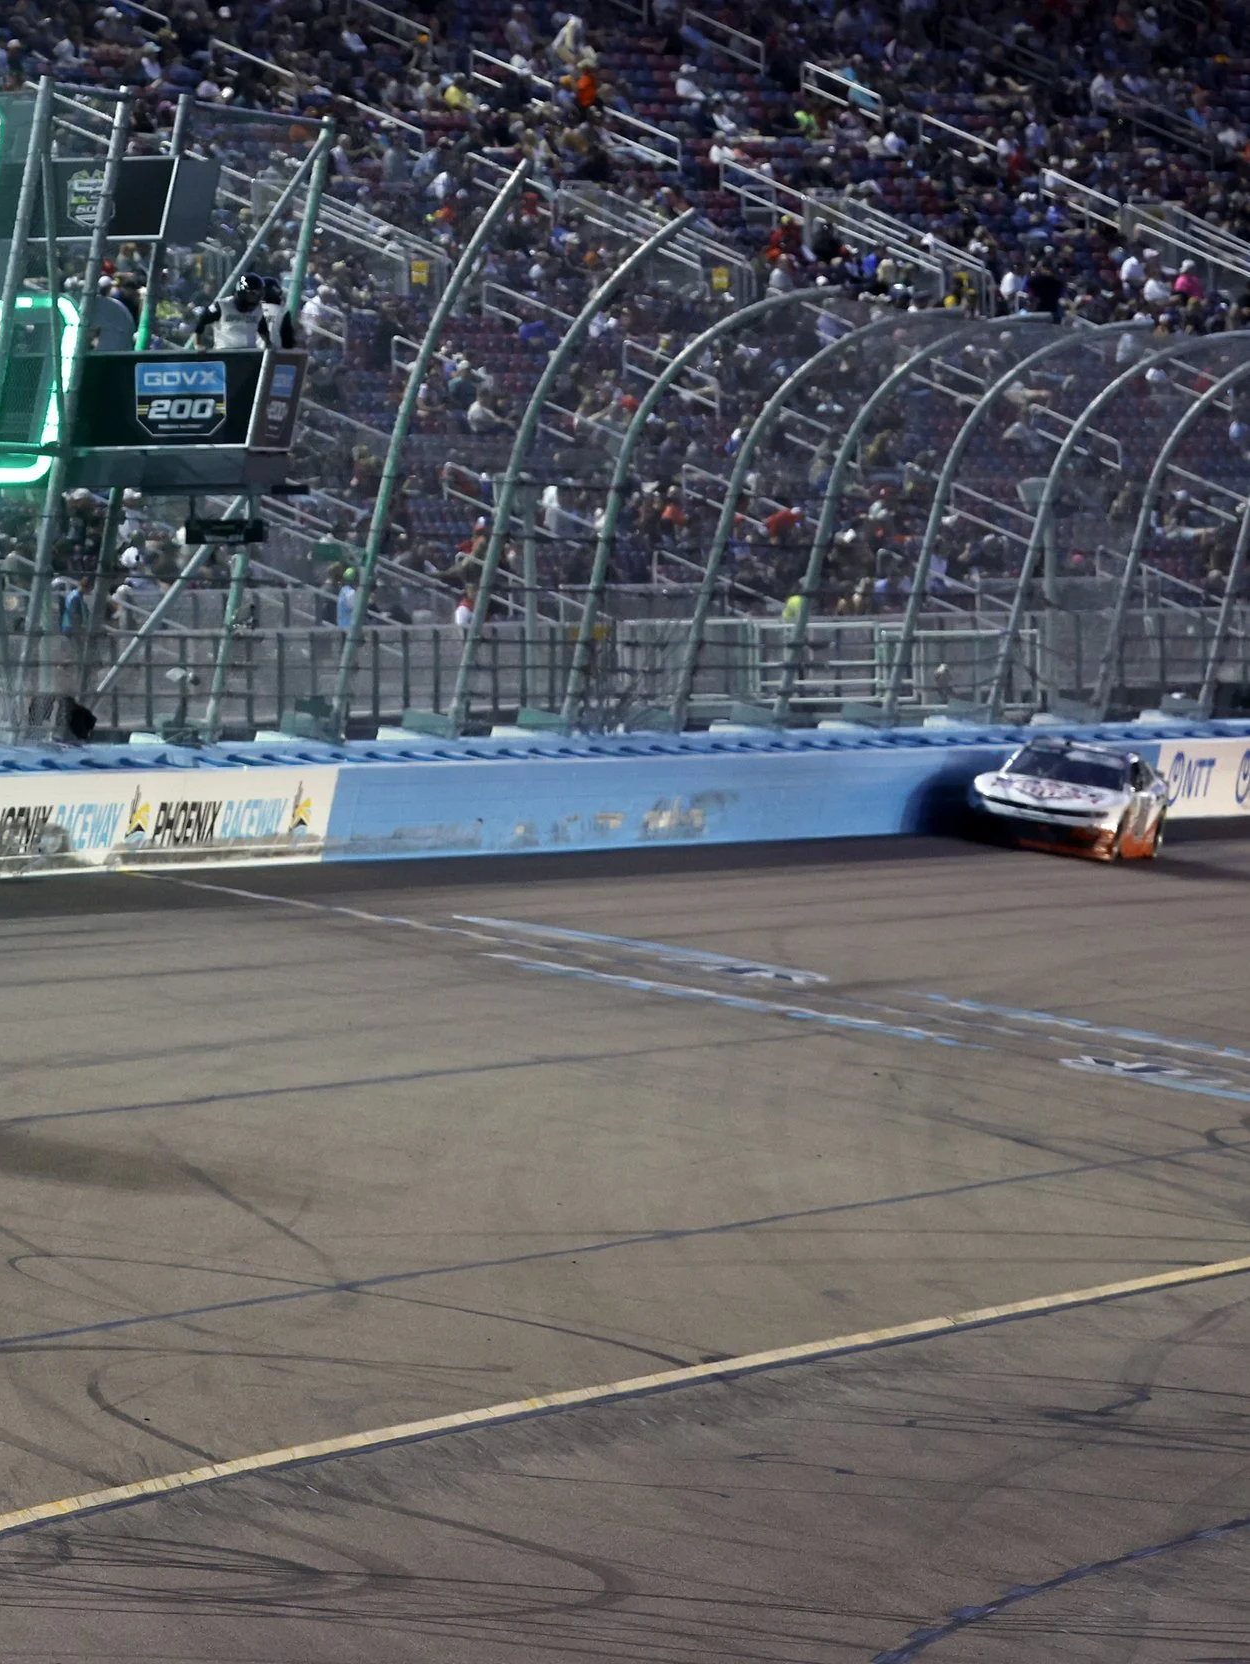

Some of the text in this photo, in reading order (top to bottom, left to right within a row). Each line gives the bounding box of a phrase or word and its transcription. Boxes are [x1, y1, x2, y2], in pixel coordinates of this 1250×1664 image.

[143, 370, 217, 387] GOVX
[147, 398, 216, 420] 200
[1181, 757, 1216, 798] NTT
[152, 798, 289, 847] PHOENIX RACEWAY
